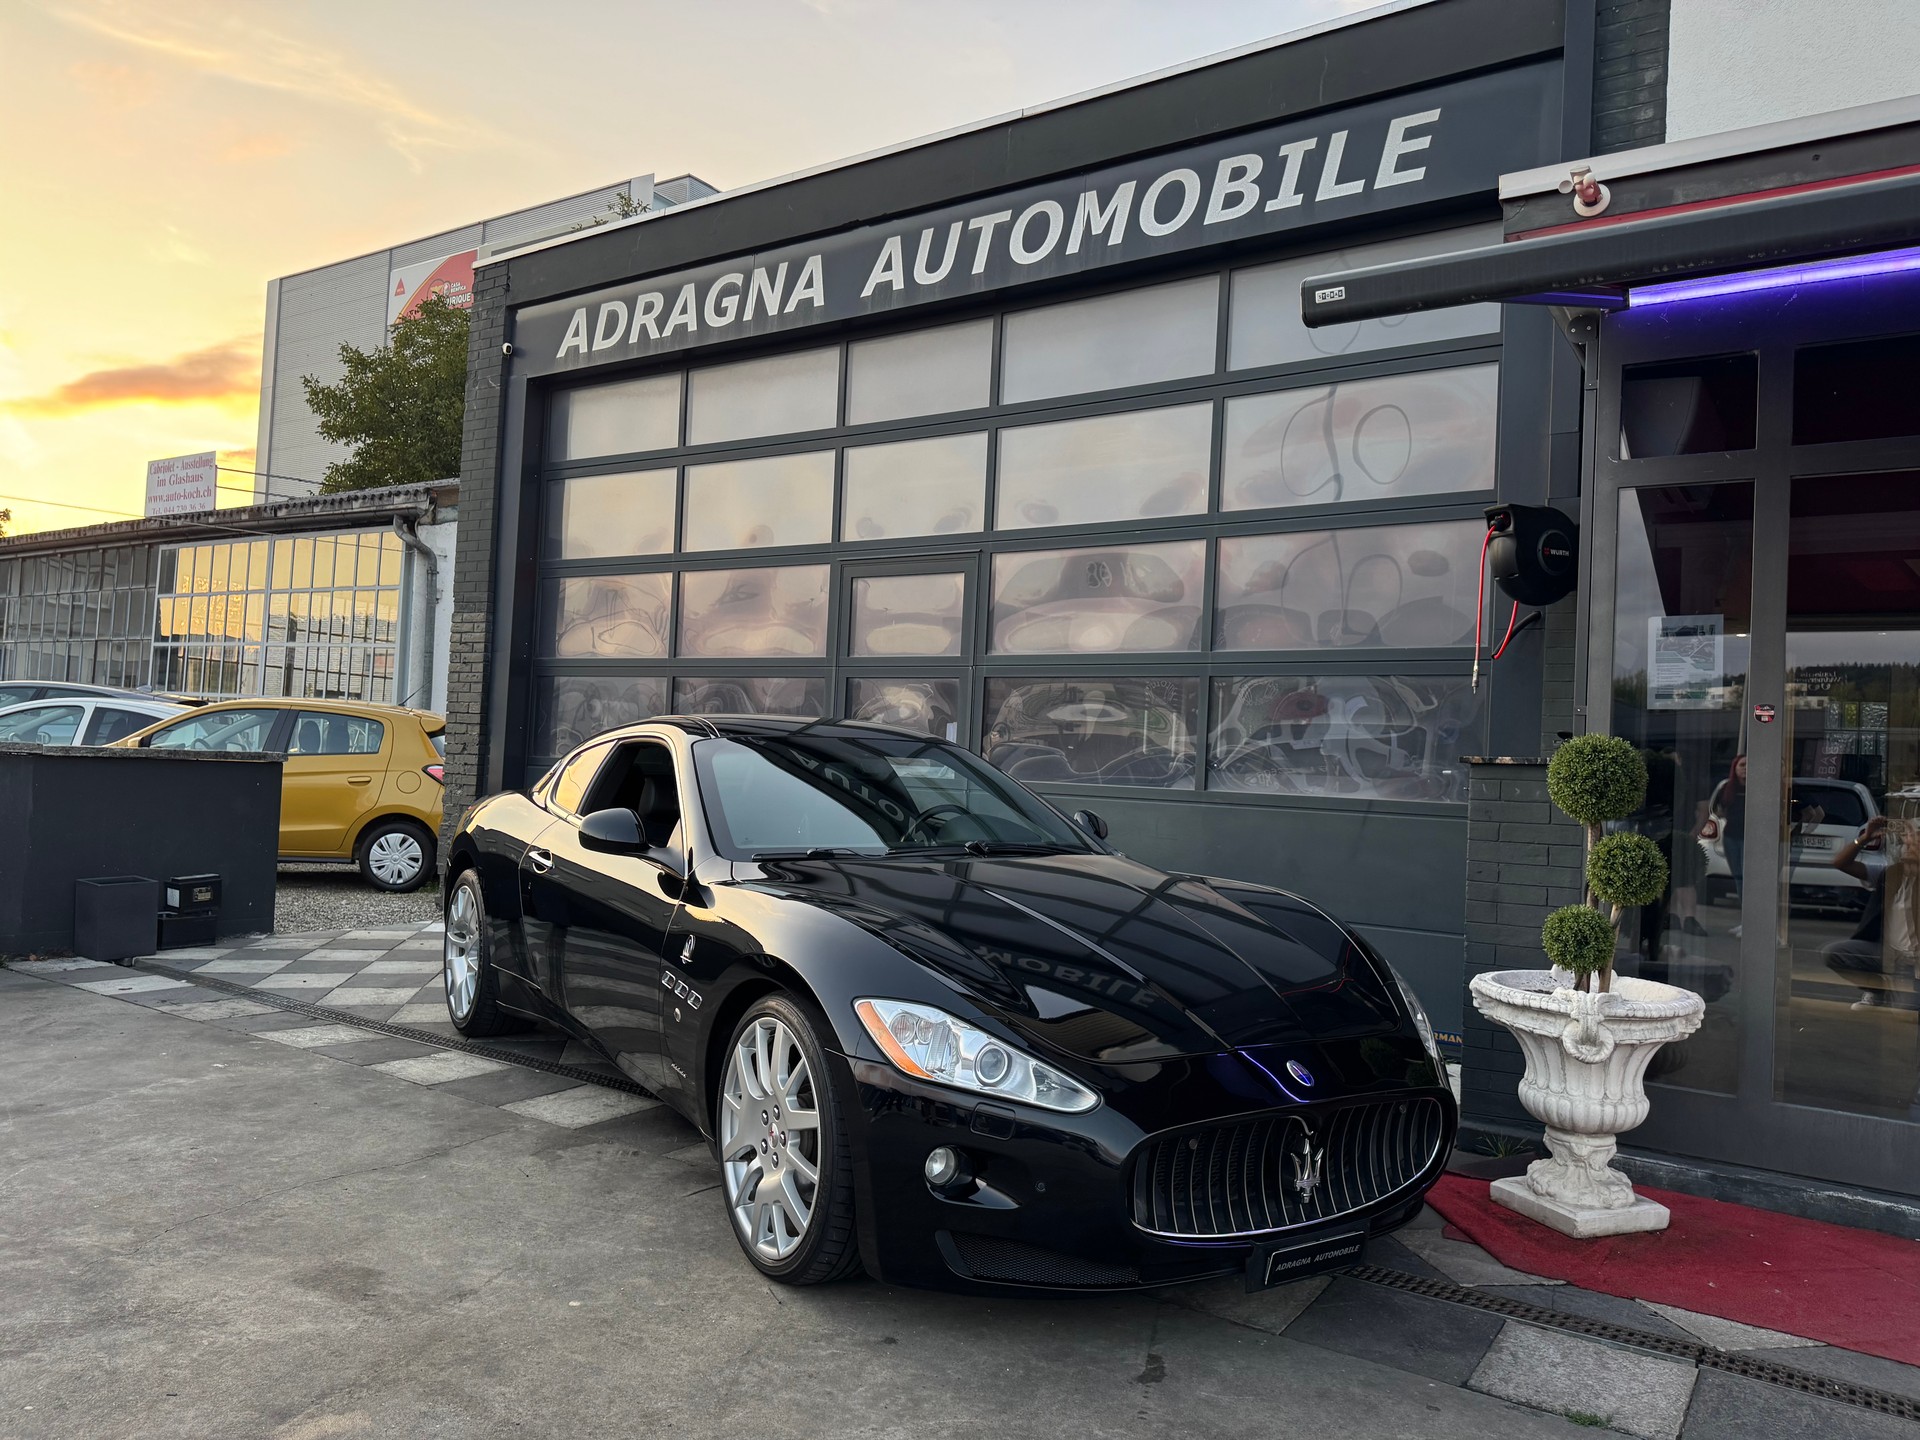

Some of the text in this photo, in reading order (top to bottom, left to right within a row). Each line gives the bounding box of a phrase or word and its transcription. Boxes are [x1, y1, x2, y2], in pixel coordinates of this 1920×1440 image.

[556, 108, 1441, 358] ADRAGNA AUTOMOBILE
[446, 293, 471, 306] URIQUE
[149, 461, 175, 475] Cabriolet
[181, 456, 214, 470] Ausstellung
[157, 472, 204, 487] im Glashaus
[148, 486, 212, 503] www.auto-koch.ch
[152, 507, 162, 515] Tel.
[164, 506, 175, 514] 044
[1434, 1032, 1463, 1043] RMAN
[1275, 1245, 1360, 1272] ADRAGNA AUTOMOBILE
